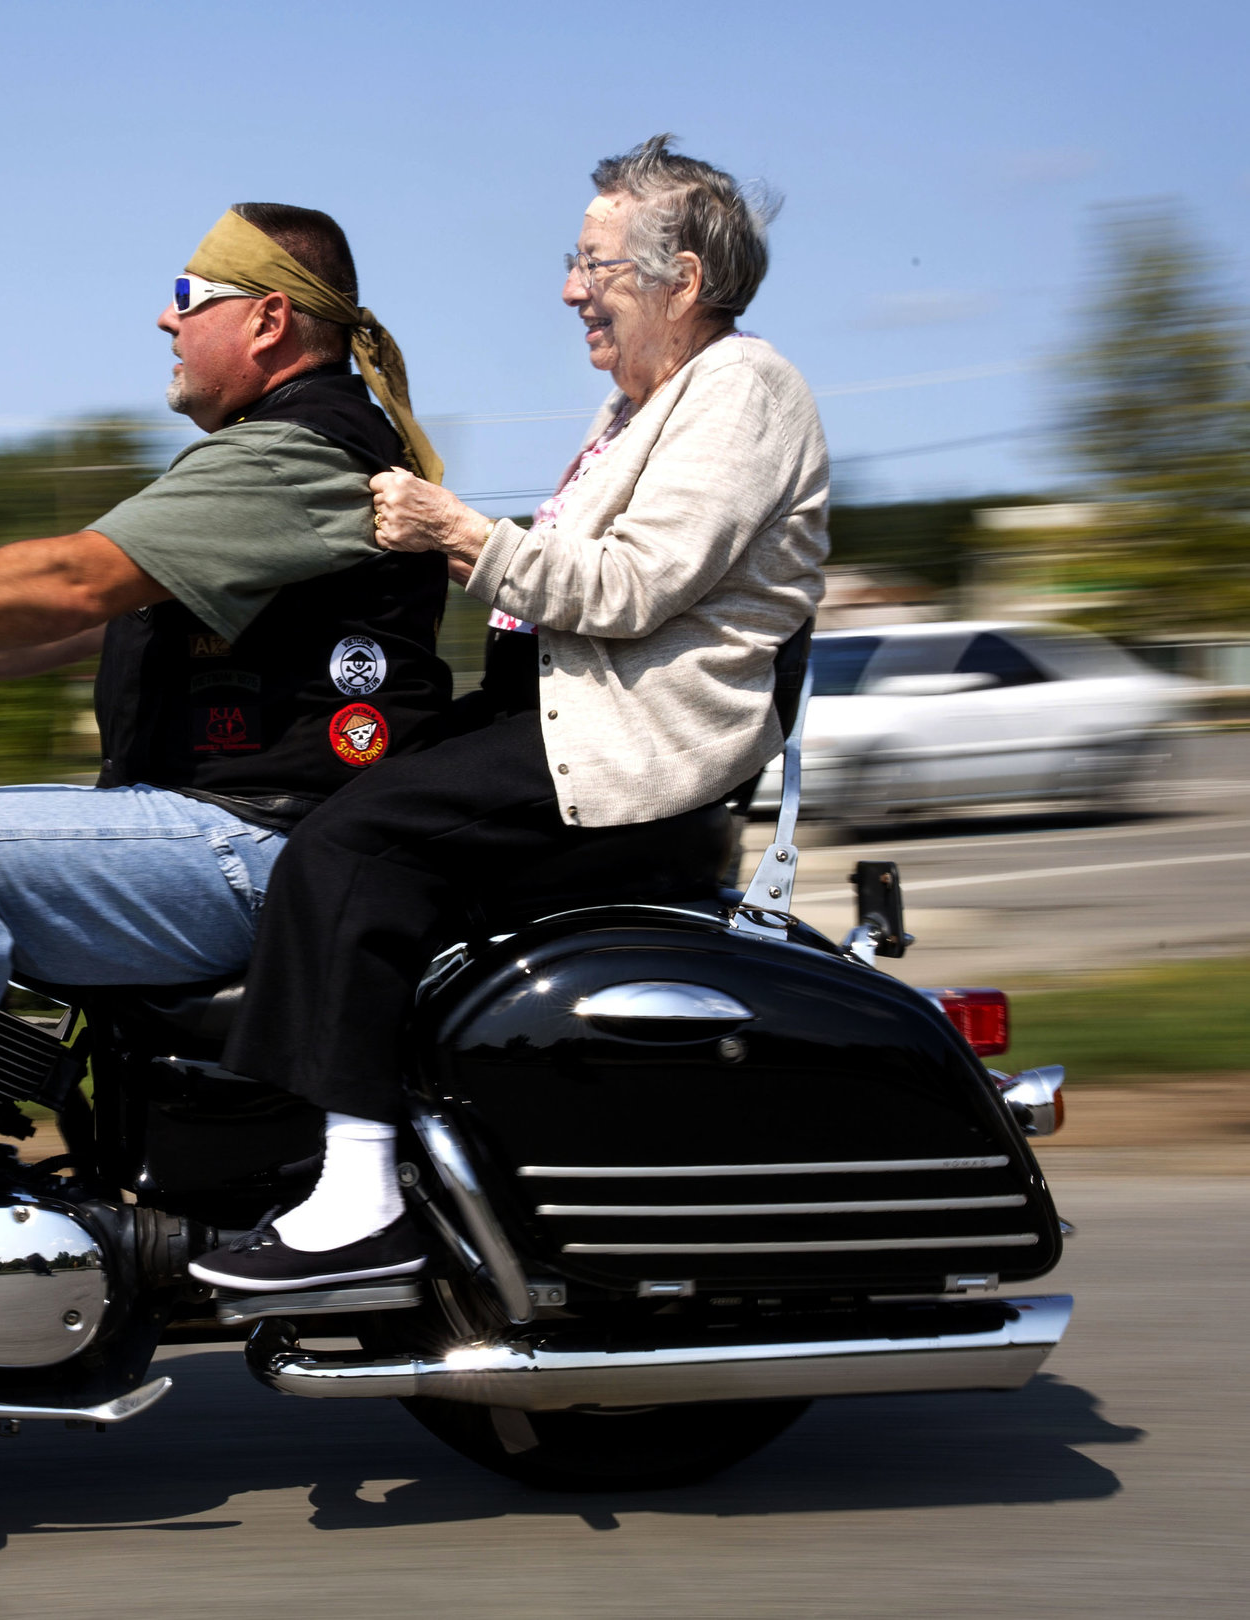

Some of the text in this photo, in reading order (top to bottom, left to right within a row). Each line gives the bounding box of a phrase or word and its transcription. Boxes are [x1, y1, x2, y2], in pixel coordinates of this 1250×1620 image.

[341, 636, 375, 648] VIETCONG
[335, 676, 381, 695] HUNTING CLUB
[209, 707, 244, 721] KIA
[943, 1160, 987, 1168] NOMAD
